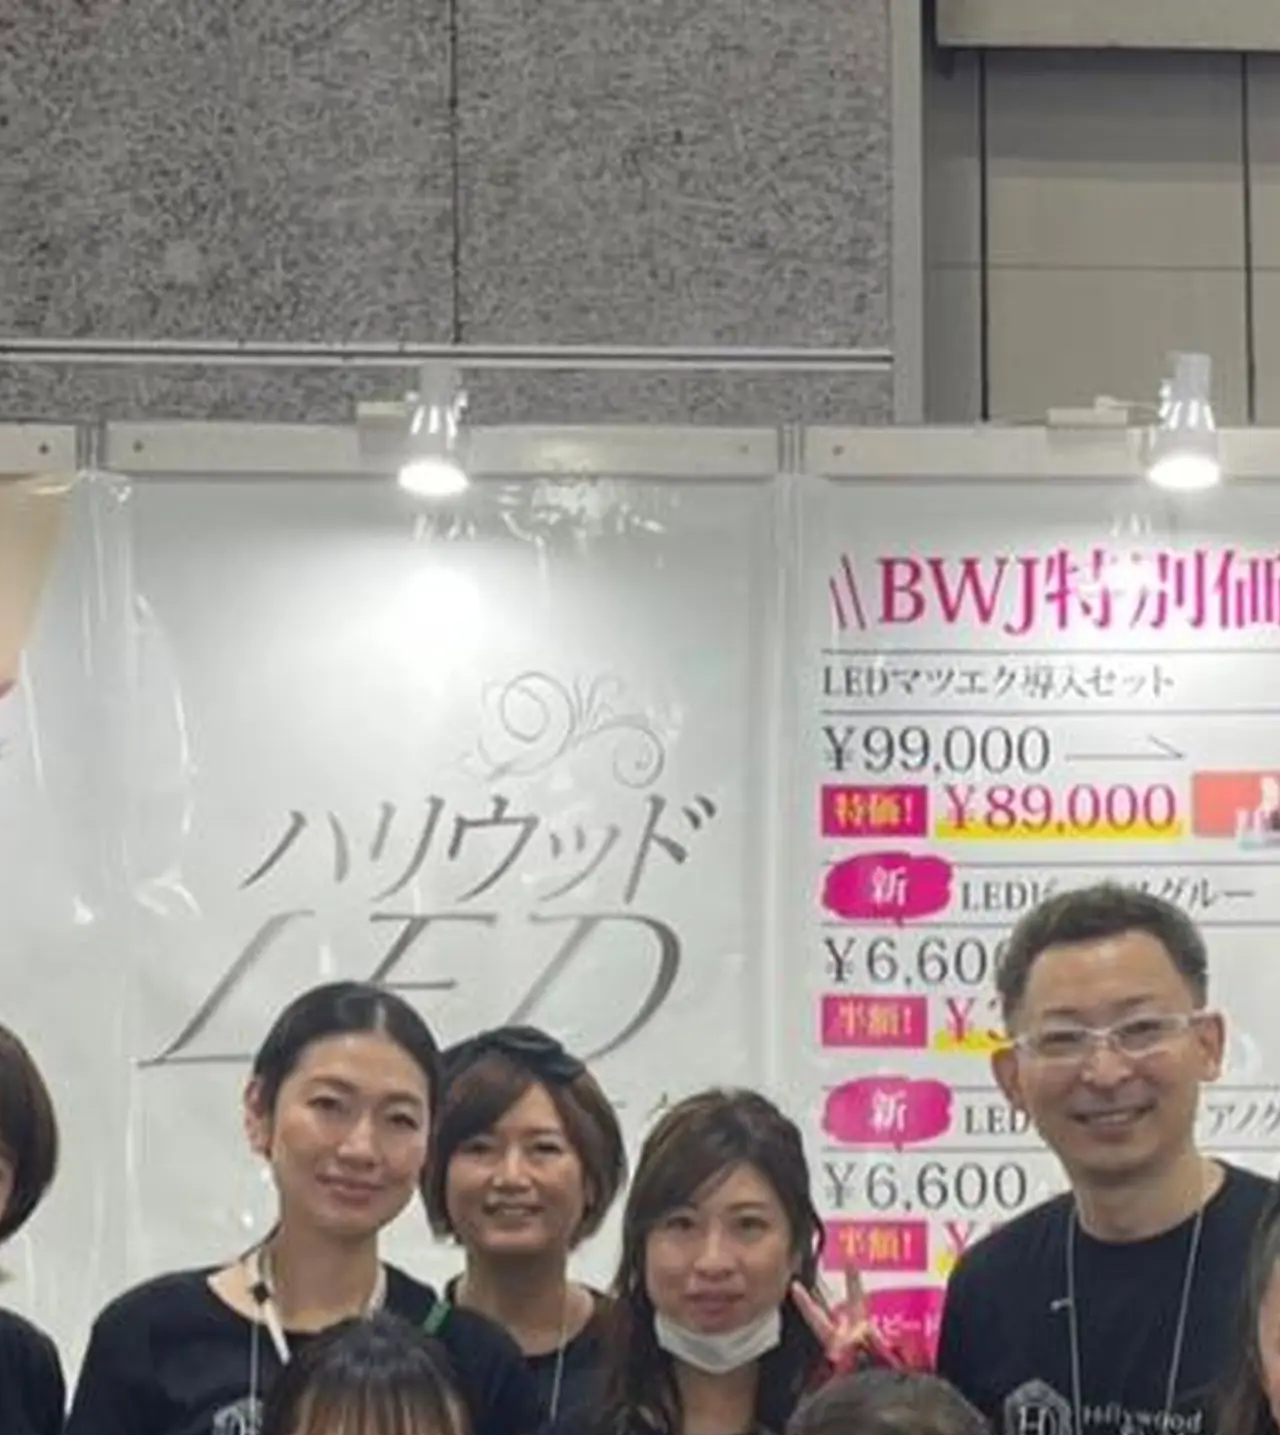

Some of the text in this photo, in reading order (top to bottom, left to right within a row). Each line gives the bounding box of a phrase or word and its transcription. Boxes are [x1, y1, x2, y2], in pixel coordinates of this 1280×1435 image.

[822, 663, 1175, 701] LEDマツエク導入セット
[822, 724, 1052, 776] ¥99,000
[944, 783, 1177, 835] ¥89,000
[237, 793, 718, 905] ハリウッド
[870, 865, 910, 907] 新
[823, 935, 1003, 987] ¥6,60
[871, 1091, 910, 1132] 新
[823, 1162, 1028, 1213] ¥6,600
